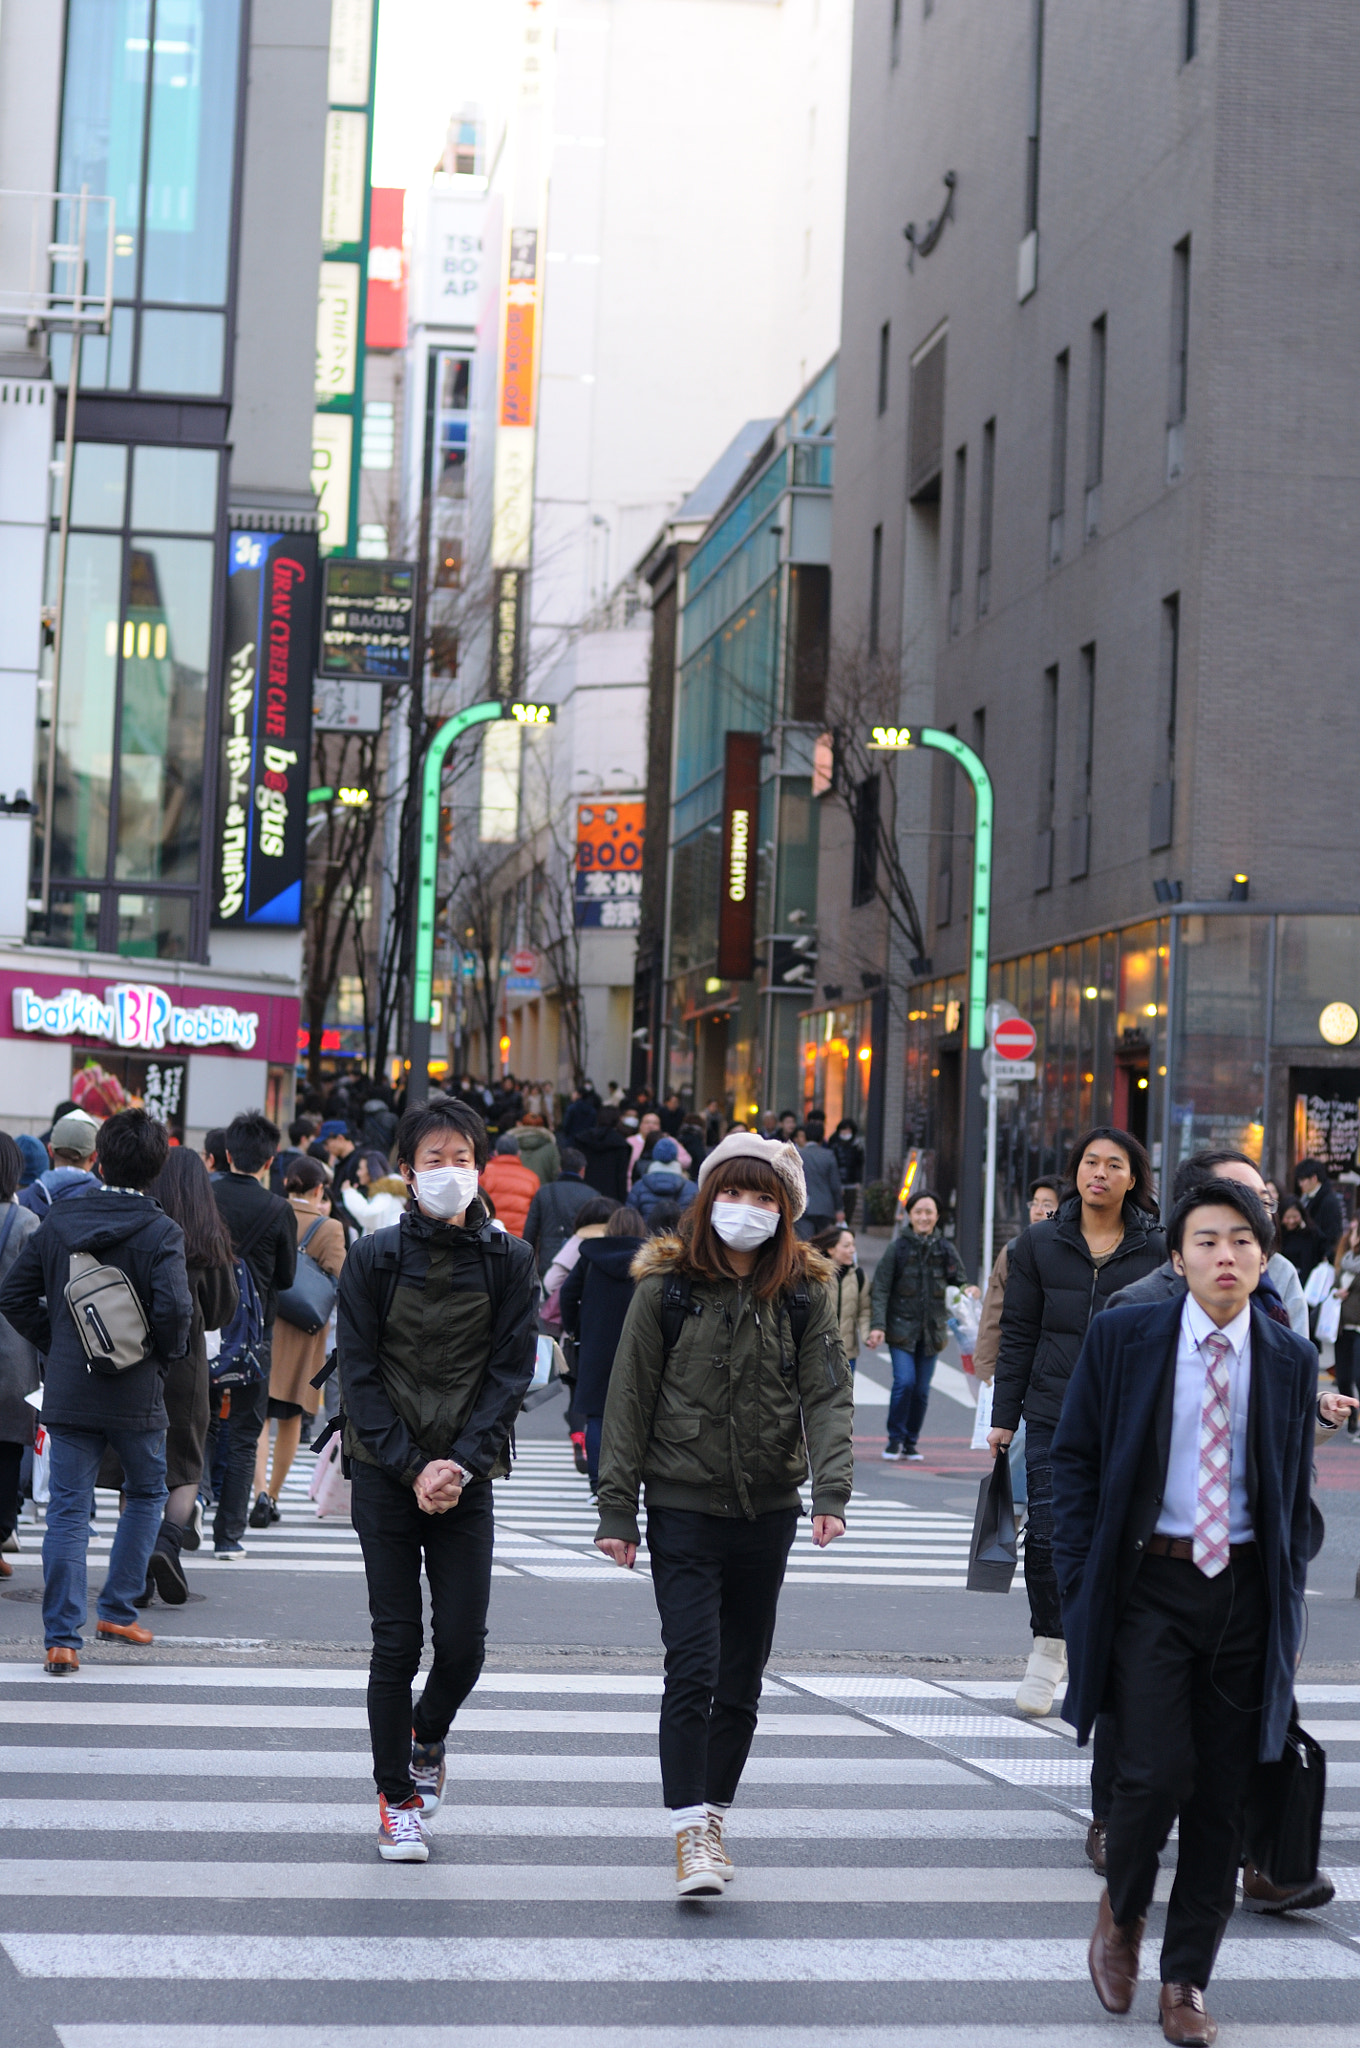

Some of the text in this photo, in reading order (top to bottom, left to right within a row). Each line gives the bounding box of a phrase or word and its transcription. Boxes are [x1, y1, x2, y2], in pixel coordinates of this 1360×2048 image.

[331, 298, 348, 384] コミック
[271, 557, 306, 620] GRAN
[348, 612, 406, 630] BAGUS
[269, 620, 291, 687] CYBER
[729, 809, 749, 902] KOMEHYO
[26, 994, 111, 1033] baskin
[174, 1011, 253, 1045] robbins
